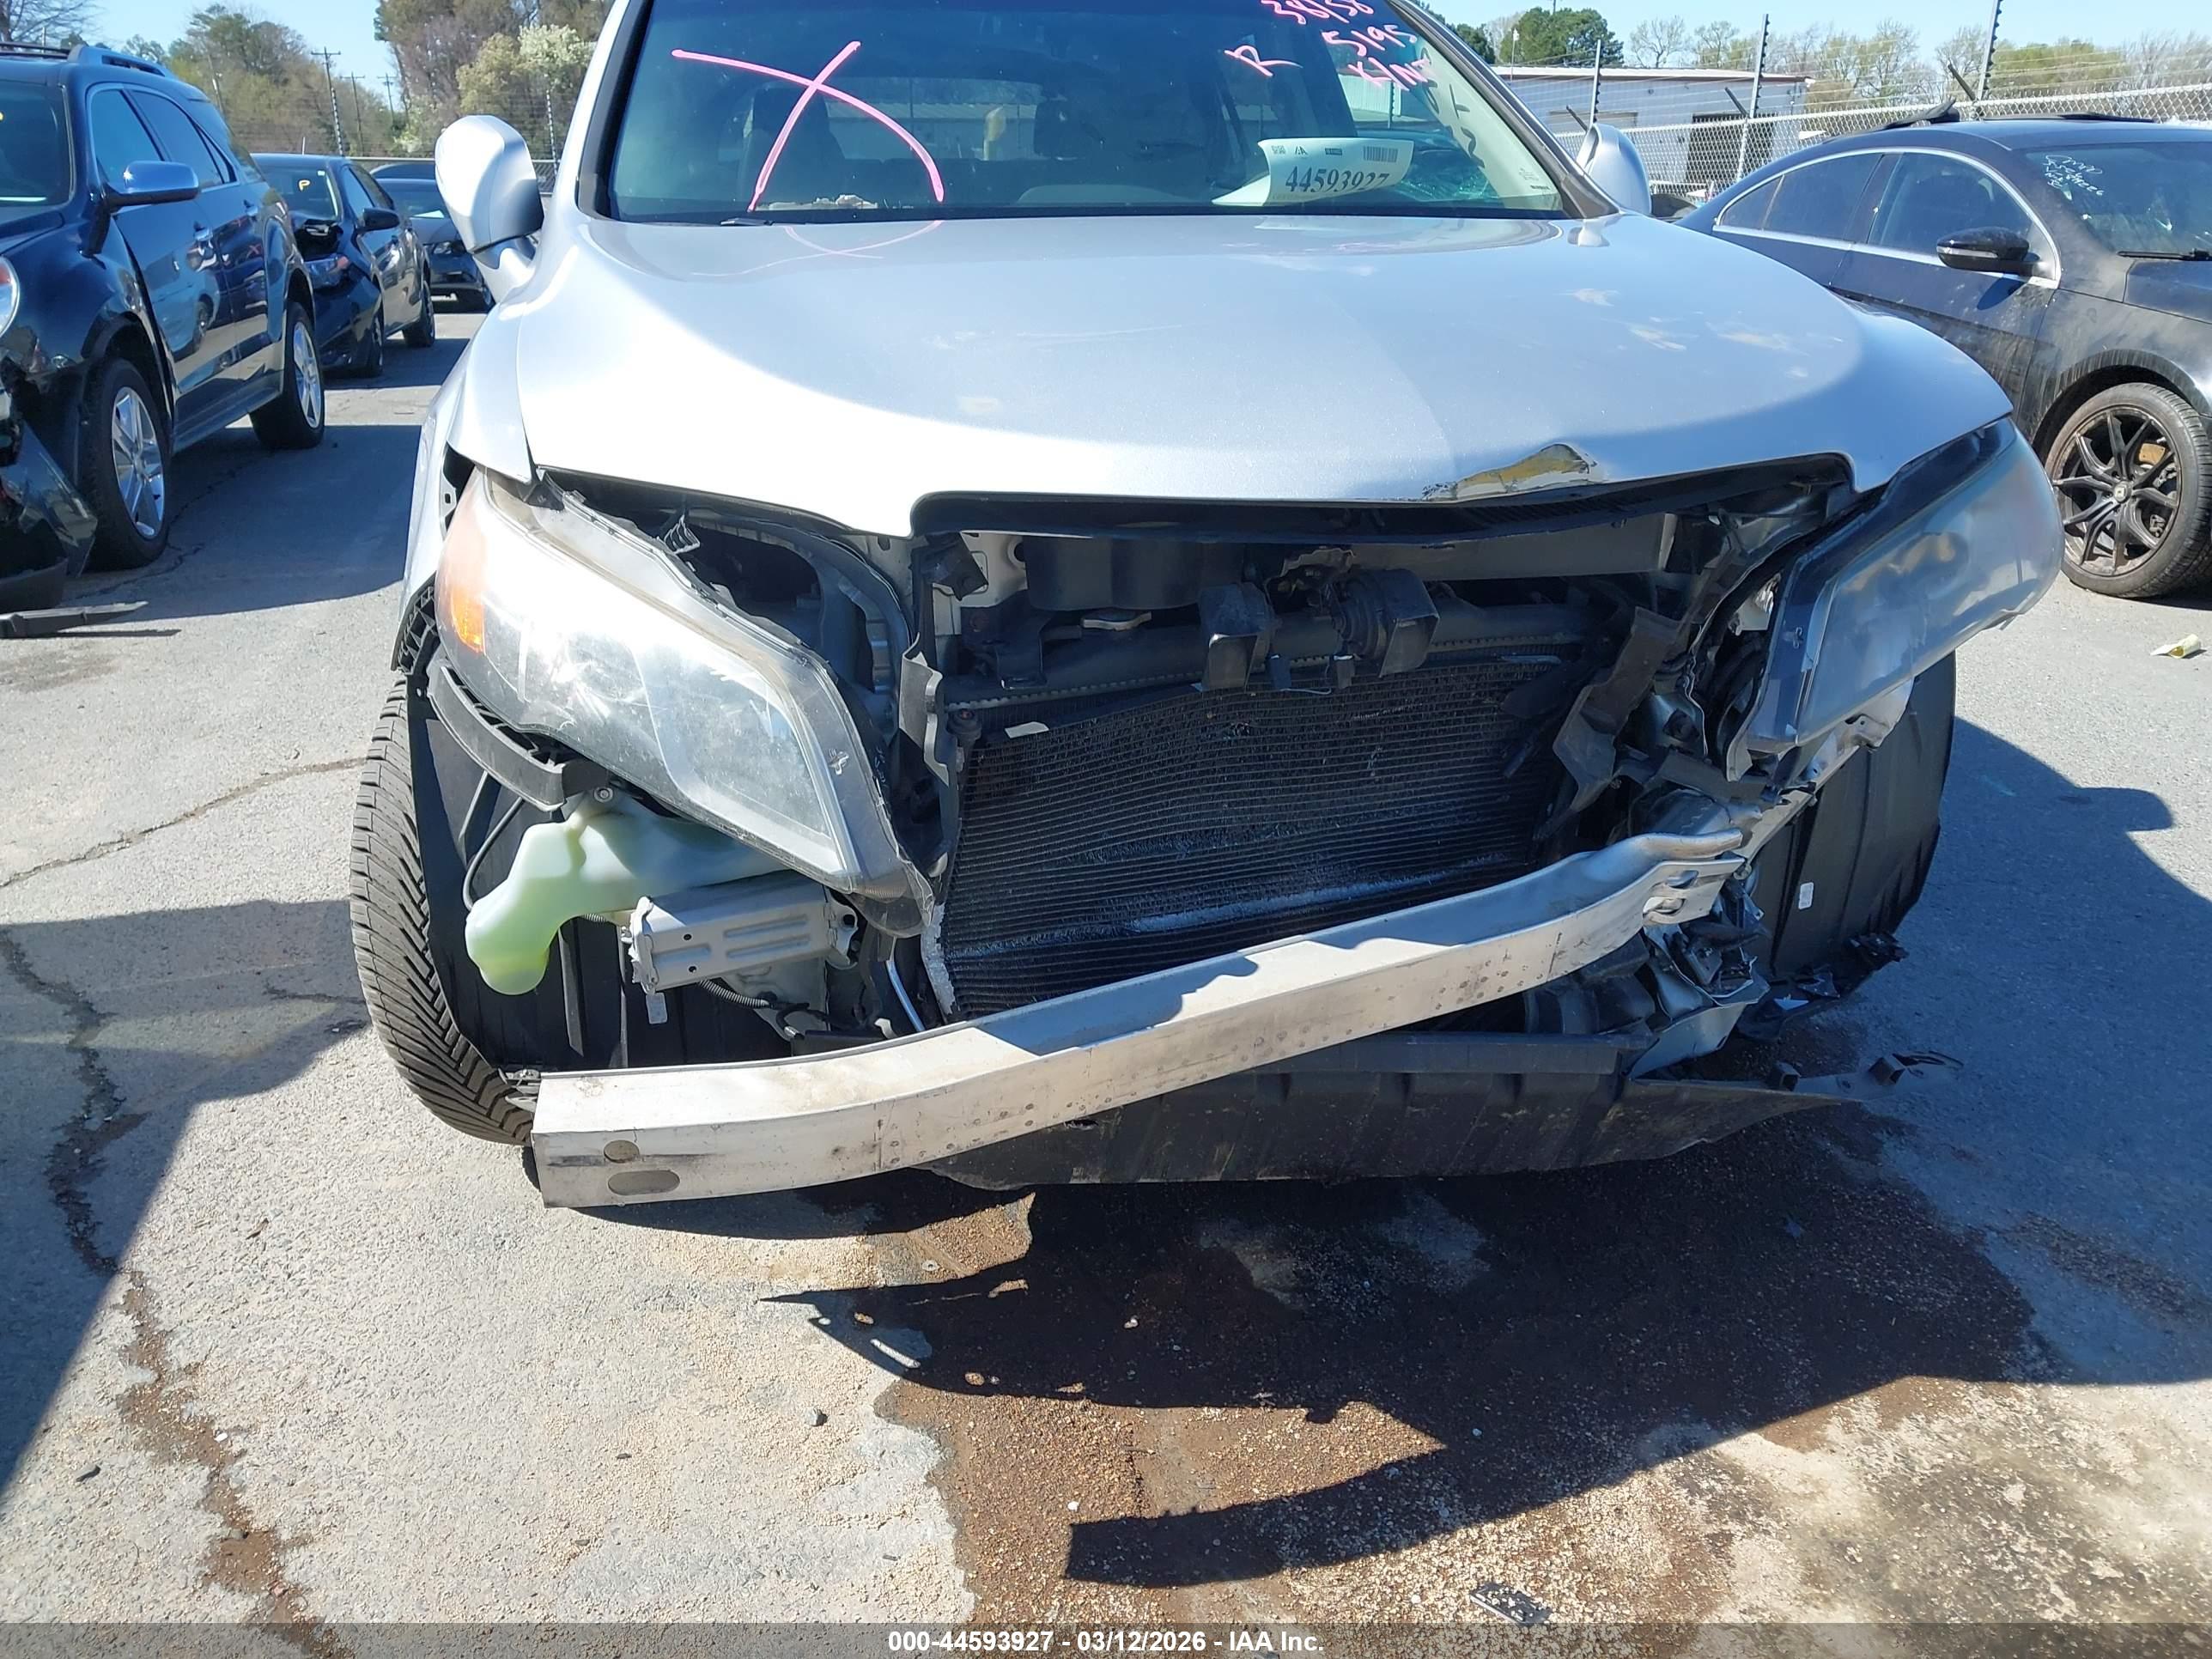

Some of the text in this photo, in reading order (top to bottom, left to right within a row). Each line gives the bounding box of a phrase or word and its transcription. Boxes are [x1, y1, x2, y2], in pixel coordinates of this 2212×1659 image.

[1224, 45, 1304, 77] R
[298, 179, 311, 191] P
[1285, 165, 1390, 193] 44593927
